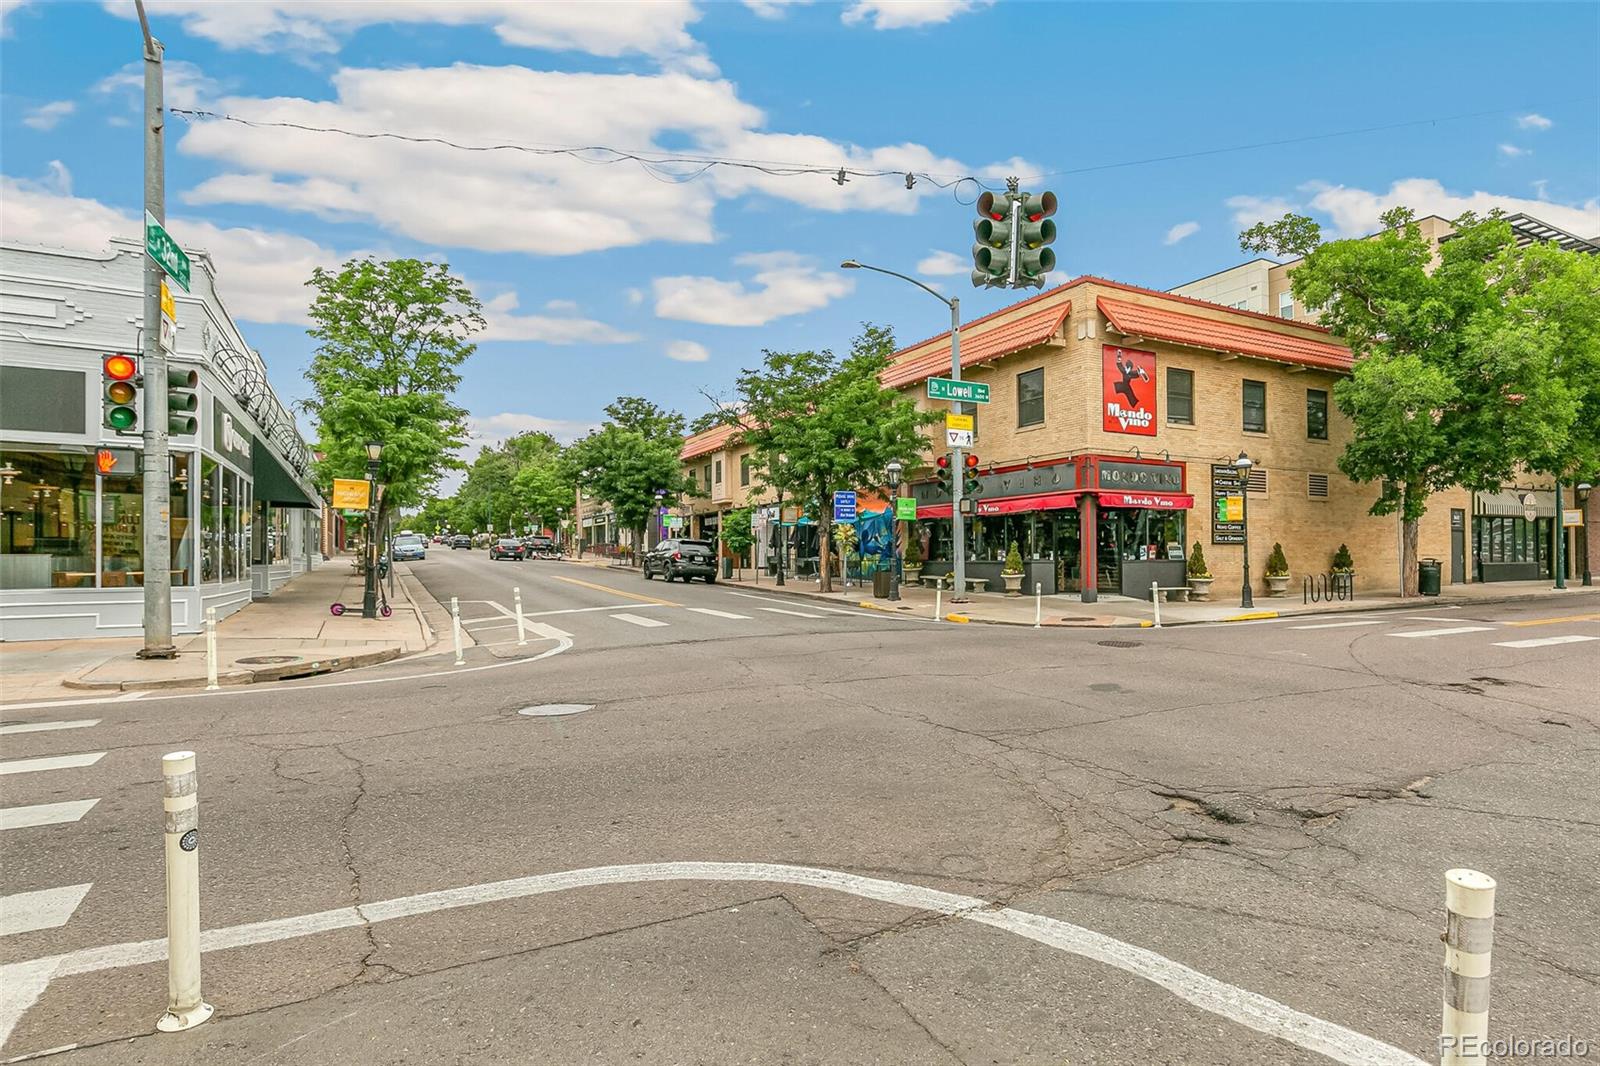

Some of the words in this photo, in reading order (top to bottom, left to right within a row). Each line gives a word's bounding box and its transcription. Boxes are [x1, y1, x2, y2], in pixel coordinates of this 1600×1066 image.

[947, 383, 973, 398] Lowell
[1118, 417, 1149, 431] Vino
[1154, 497, 1173, 506] Vino
[983, 504, 999, 513] Vino
